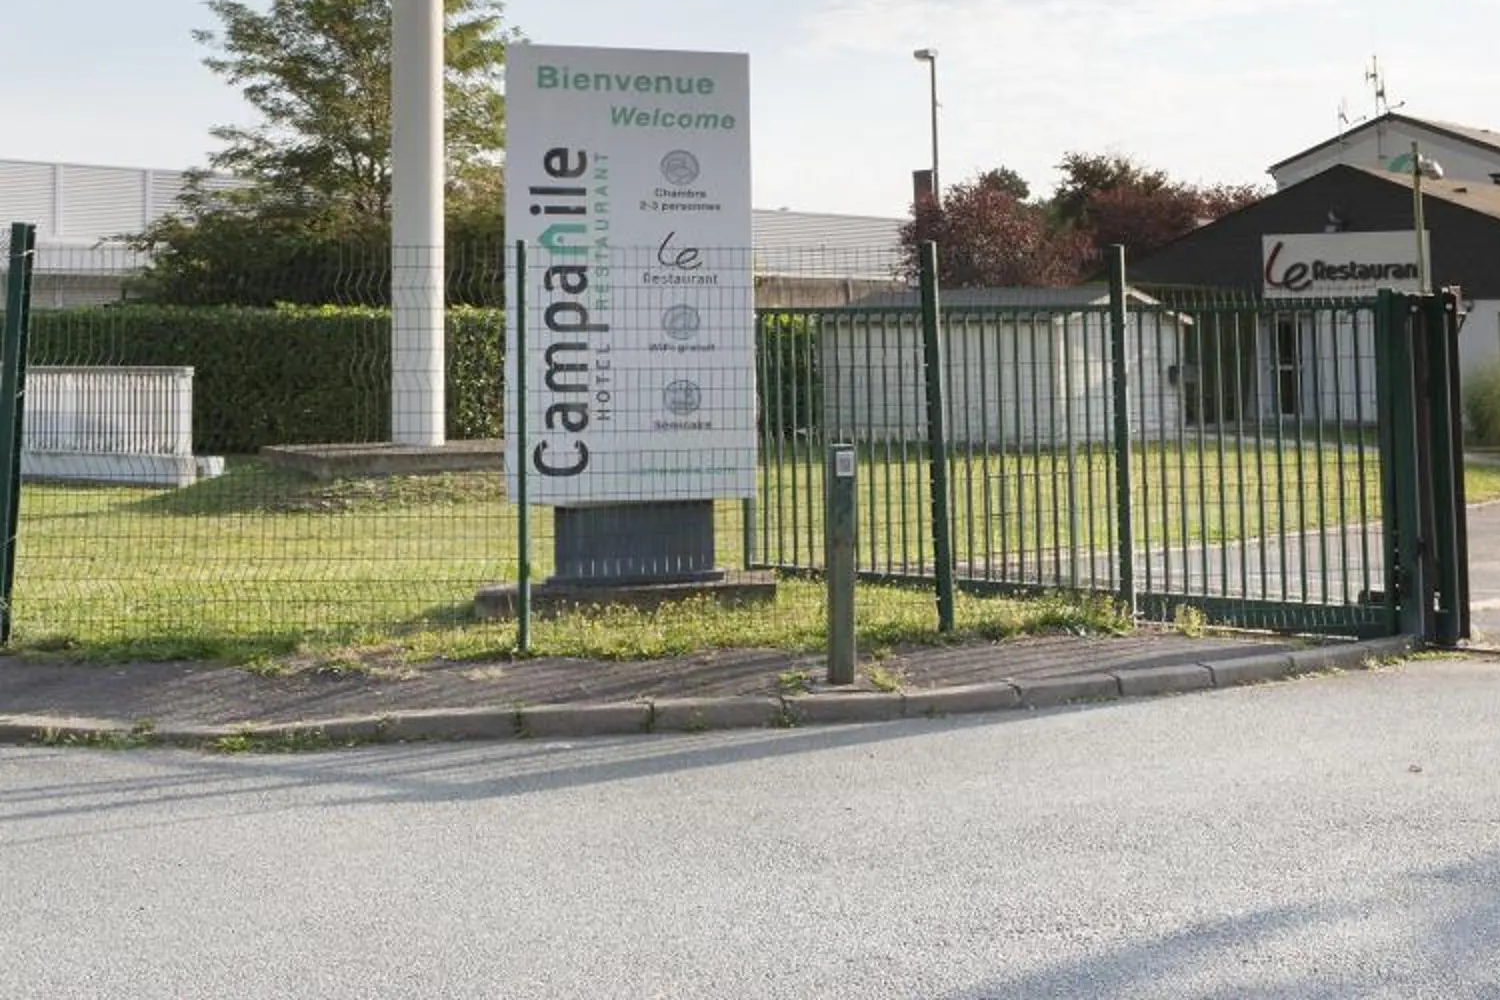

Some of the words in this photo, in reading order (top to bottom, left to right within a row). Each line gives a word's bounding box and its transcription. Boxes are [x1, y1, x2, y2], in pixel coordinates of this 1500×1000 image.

[537, 65, 715, 95] Bienvenue
[611, 105, 736, 130] Welcome
[594, 152, 610, 310] RESTAURANT
[658, 231, 703, 270] Le
[643, 272, 718, 285] Restaurant
[1266, 241, 1314, 291] Le
[1314, 260, 1418, 281] Restauran
[529, 146, 609, 477] Campanile
[596, 343, 611, 421] HOTEL
